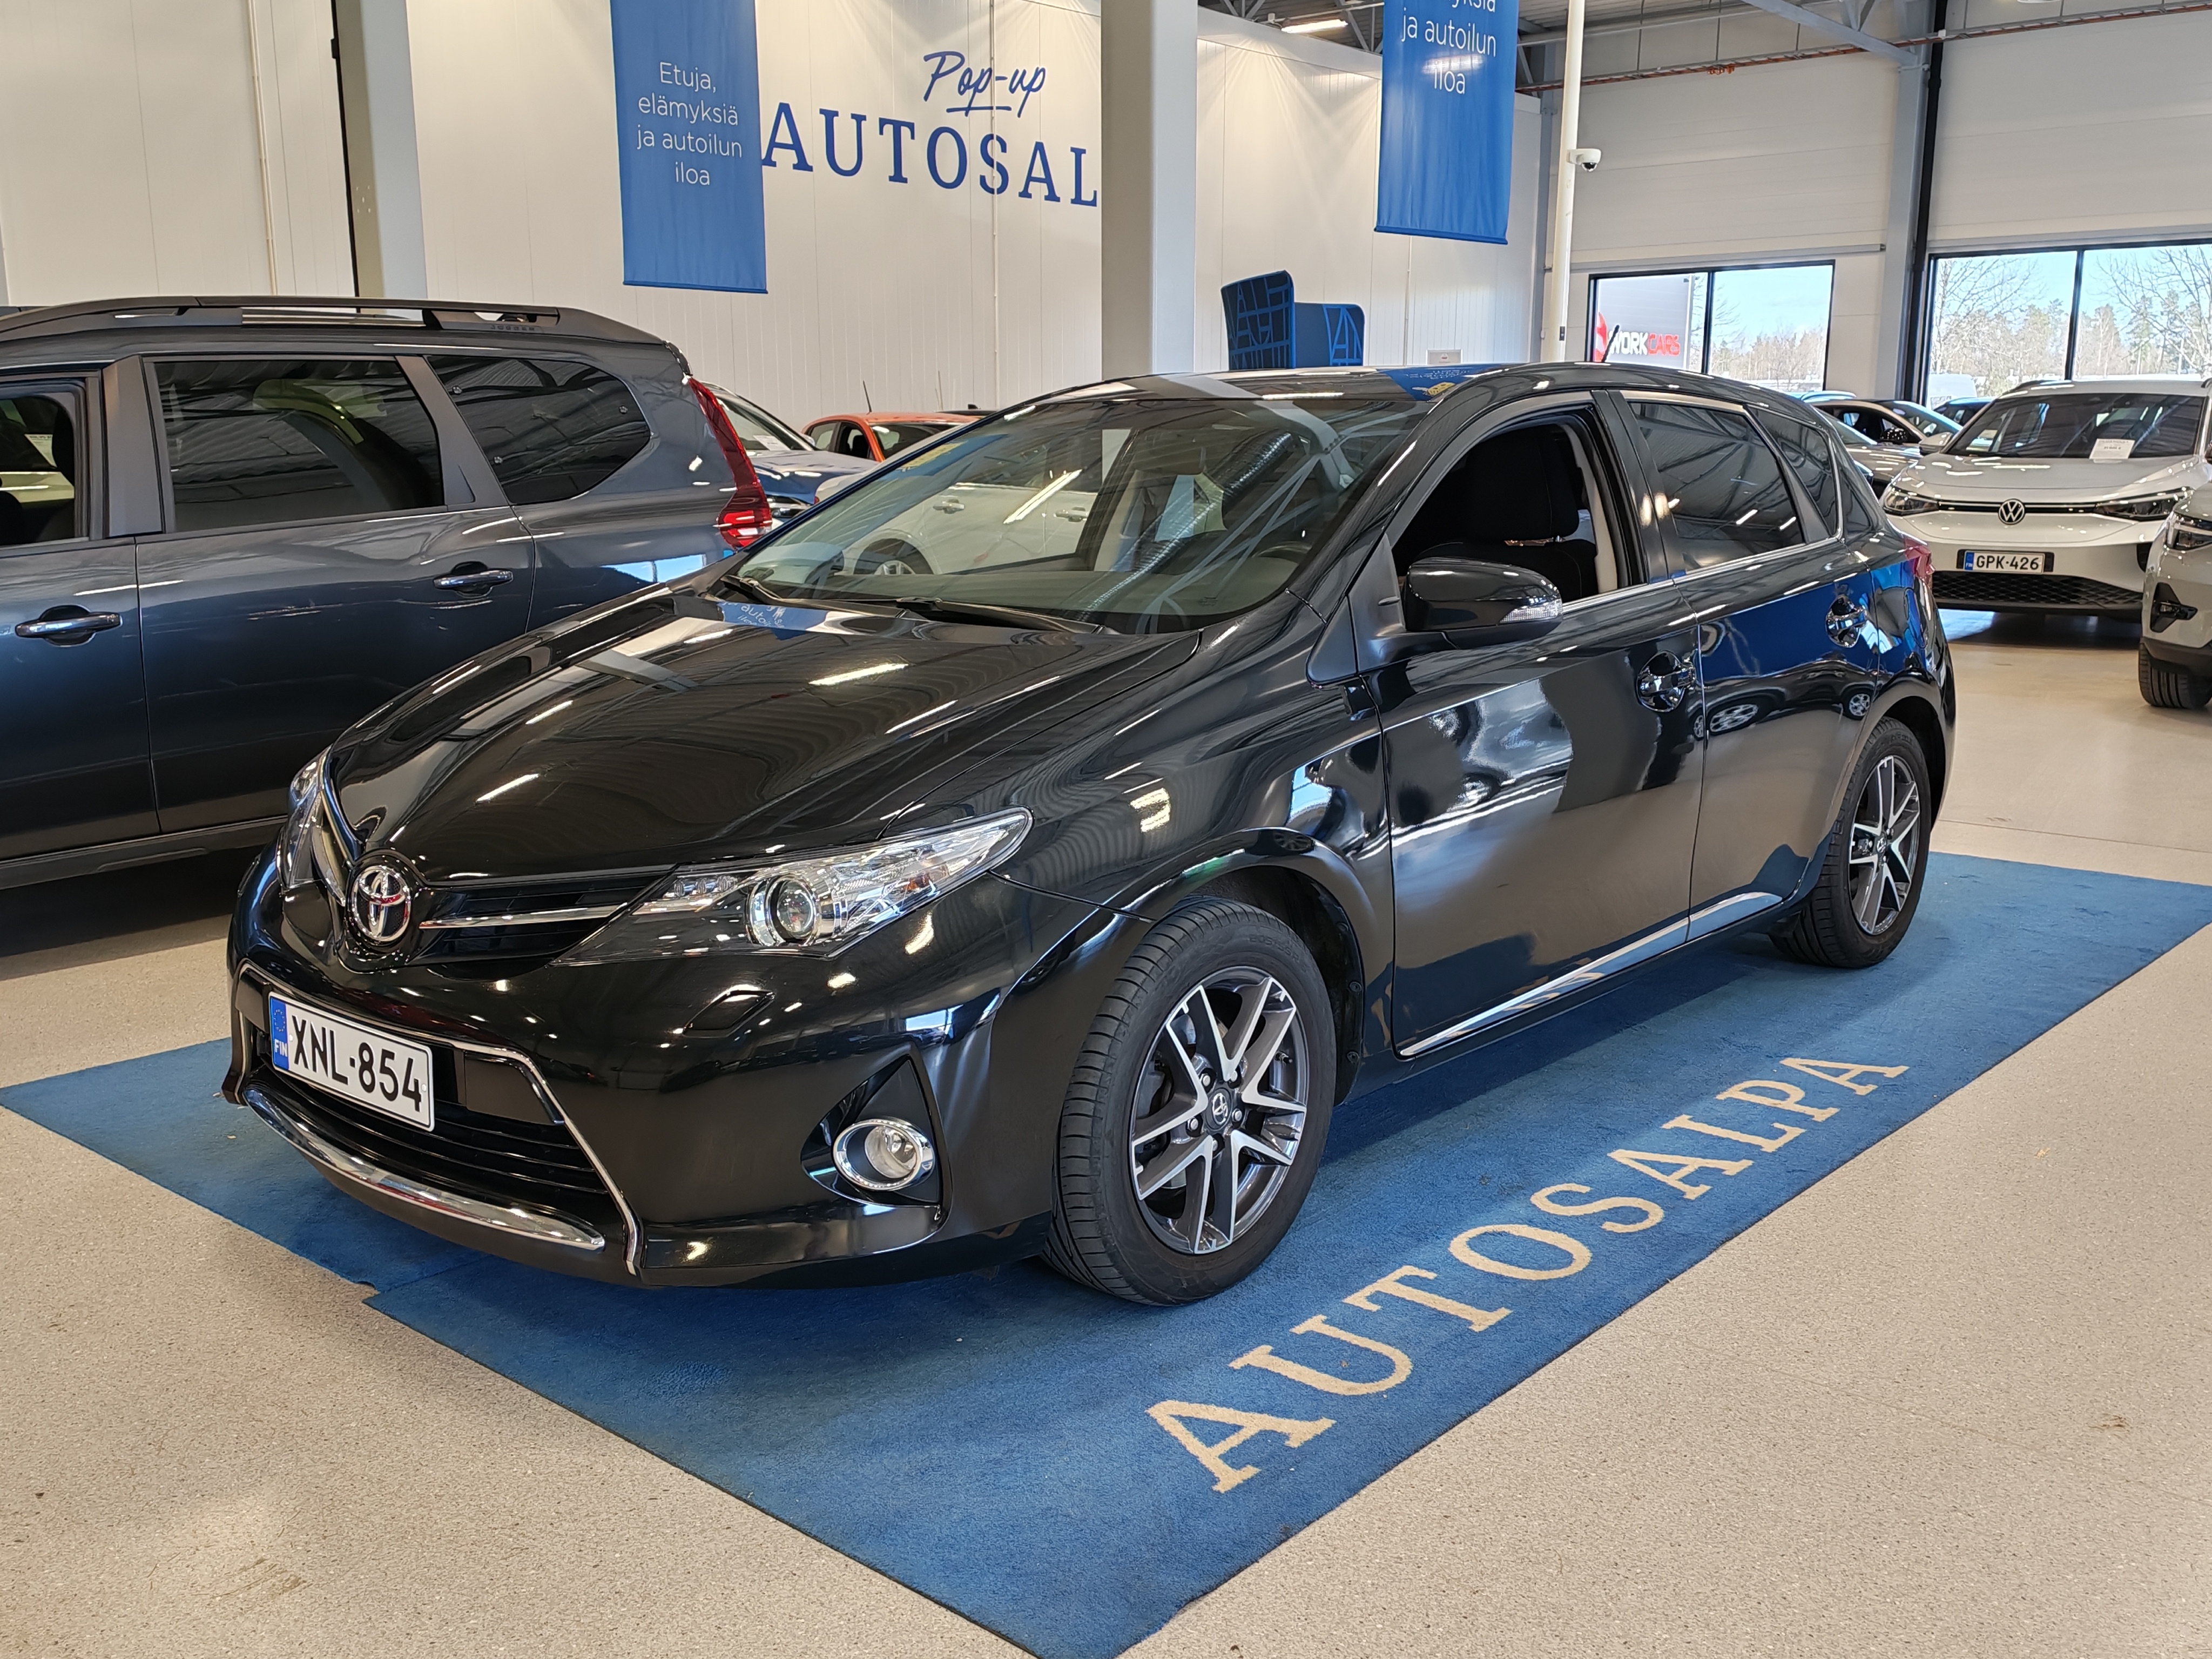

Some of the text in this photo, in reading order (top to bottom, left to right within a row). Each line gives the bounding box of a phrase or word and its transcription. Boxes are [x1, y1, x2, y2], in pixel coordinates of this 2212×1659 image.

[1401, 6, 1496, 58] ja autoilun
[659, 61, 717, 93] Etuja,
[923, 51, 1047, 118] Pop-up
[1434, 60, 1466, 95] iloa
[638, 92, 738, 126] elämyksiä
[637, 124, 742, 158] ja autoilun
[762, 102, 1098, 207] AUTOSAL
[675, 161, 711, 186] iloa
[1976, 555, 2040, 570] GPK-426
[274, 1038, 288, 1057] FIN
[292, 1015, 422, 1112] XNL-854
[1147, 1057, 1908, 1493] AUTOSALPA
